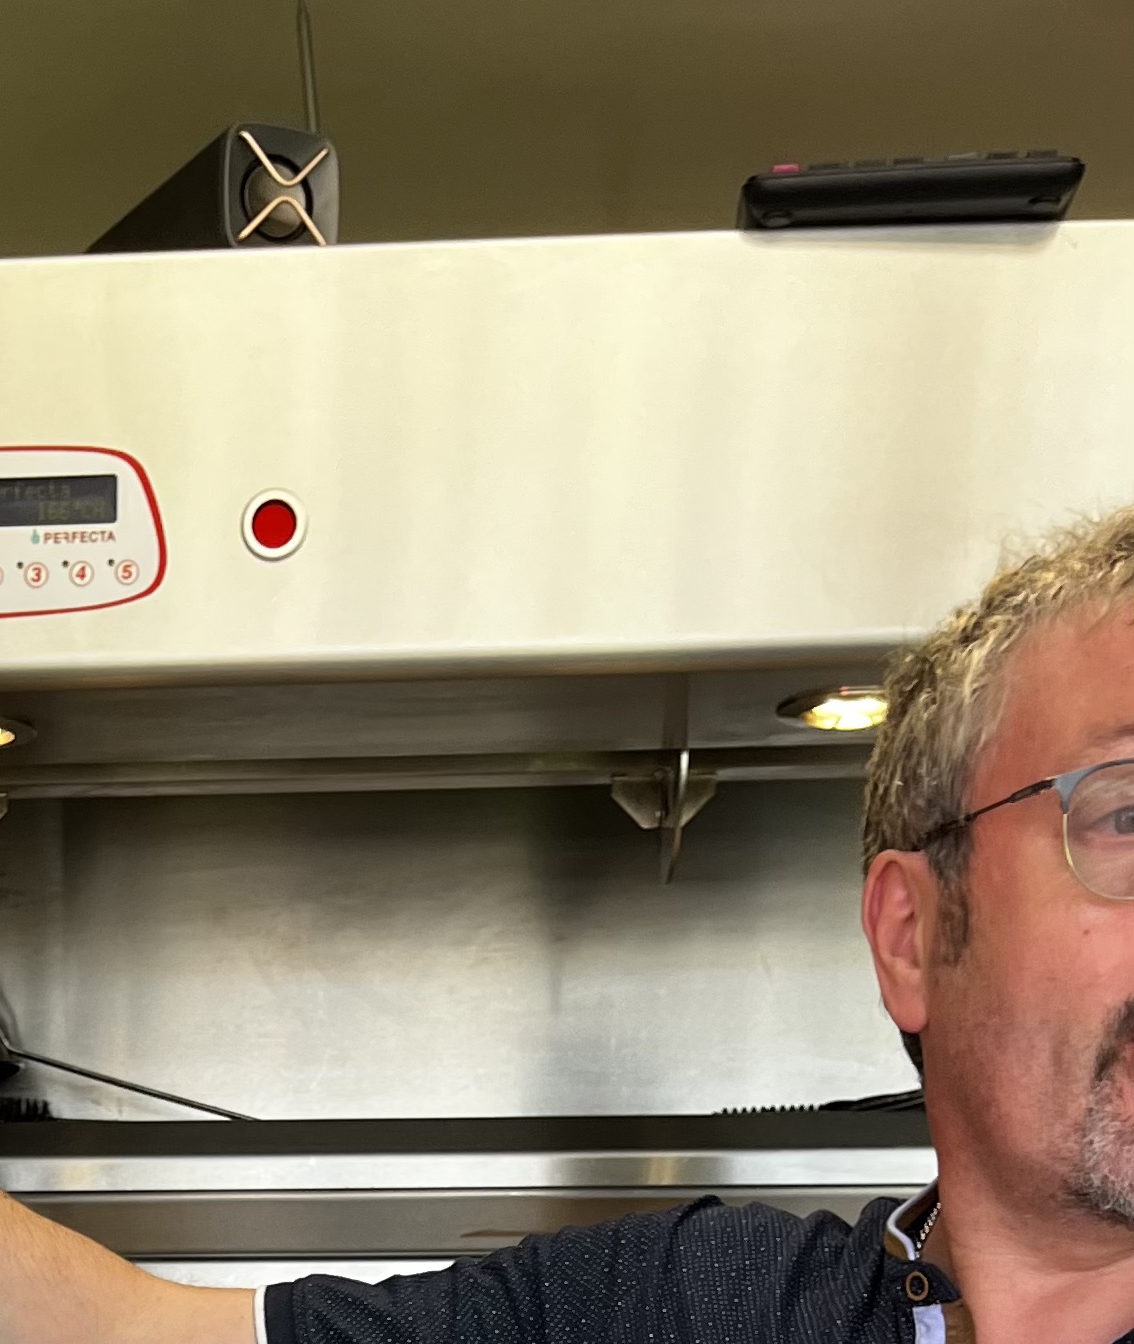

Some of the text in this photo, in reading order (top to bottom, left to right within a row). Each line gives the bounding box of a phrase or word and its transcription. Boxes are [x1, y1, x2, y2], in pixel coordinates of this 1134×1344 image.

[43, 530, 116, 544] PERFECTA
[31, 566, 42, 582] 3
[75, 565, 86, 581] 4
[121, 564, 133, 580] 5
